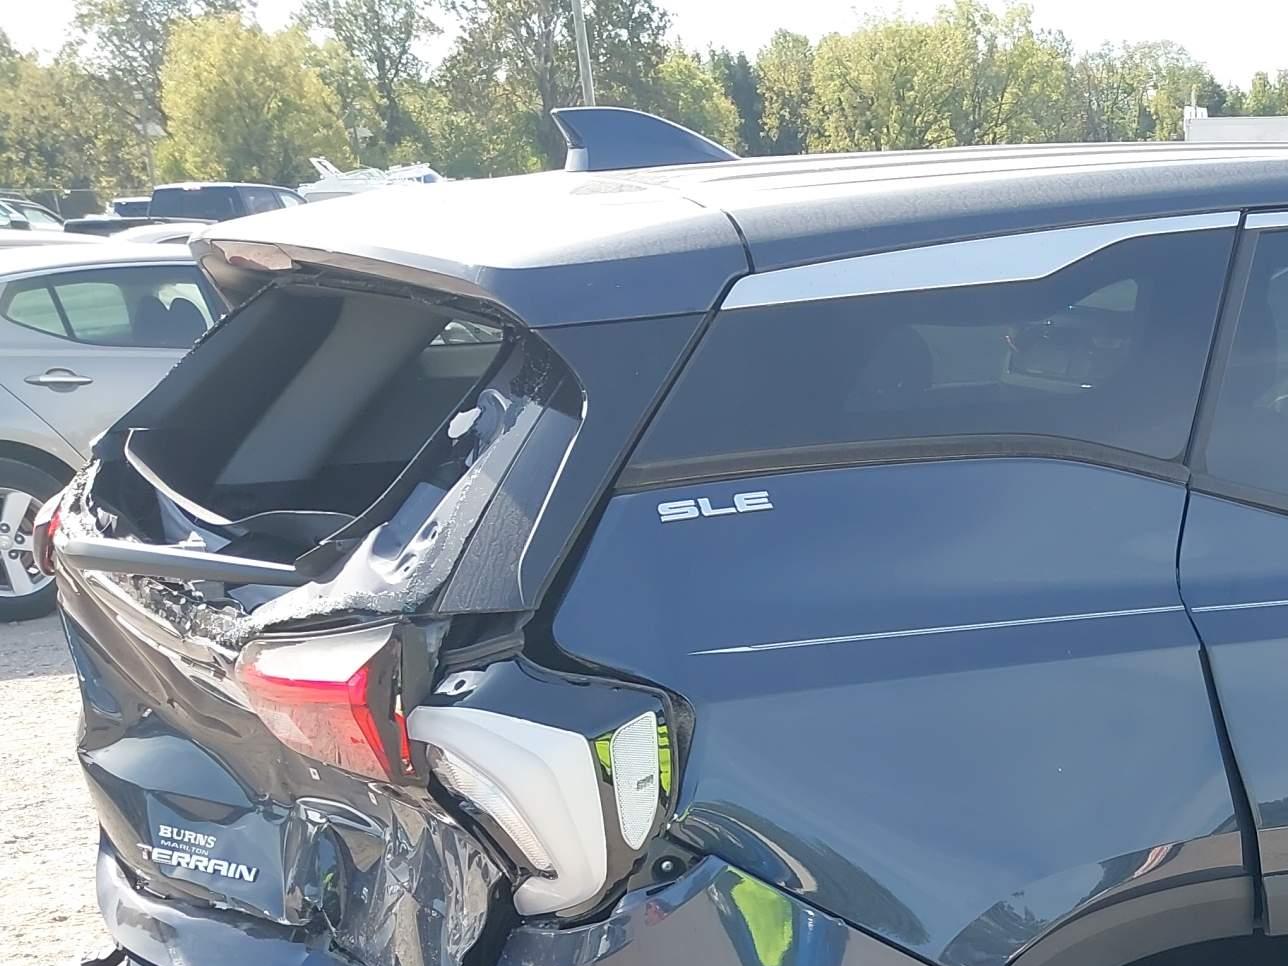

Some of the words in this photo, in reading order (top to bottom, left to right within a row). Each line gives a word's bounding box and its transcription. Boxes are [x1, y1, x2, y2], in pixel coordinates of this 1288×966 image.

[657, 490, 774, 523] SLE
[158, 824, 217, 848] BURNS
[160, 839, 209, 856] MARLTON
[136, 842, 258, 882] TERRAIN
